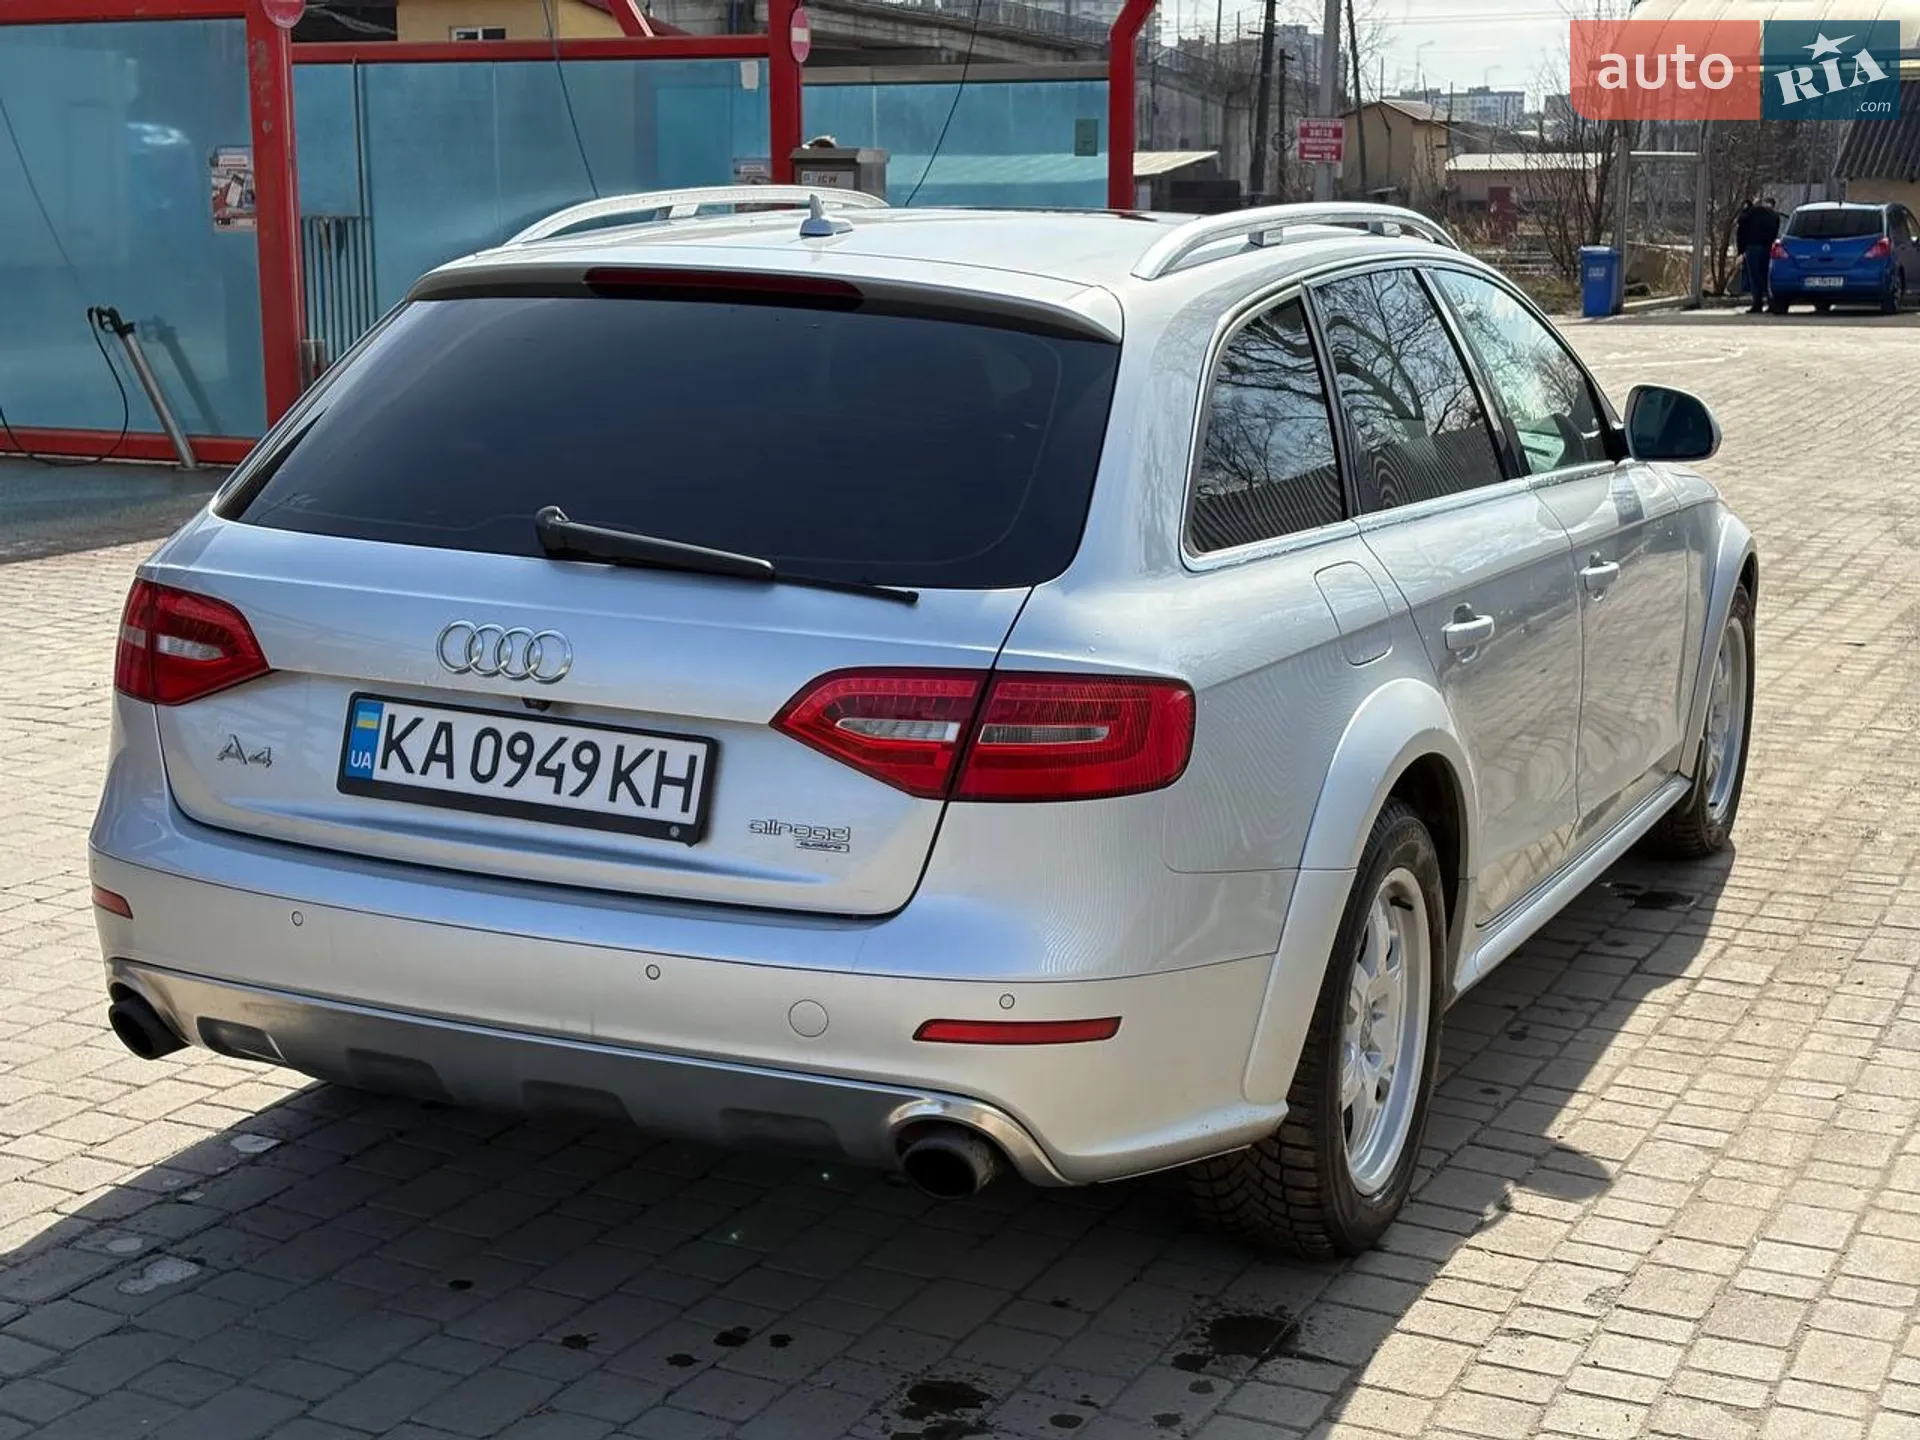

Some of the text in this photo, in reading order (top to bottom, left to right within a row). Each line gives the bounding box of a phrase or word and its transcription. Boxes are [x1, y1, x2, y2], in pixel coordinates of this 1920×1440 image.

[216, 733, 273, 768] A4
[350, 749, 372, 770] UA
[380, 714, 698, 813] KA 0949 KH
[748, 819, 851, 842] allroad
